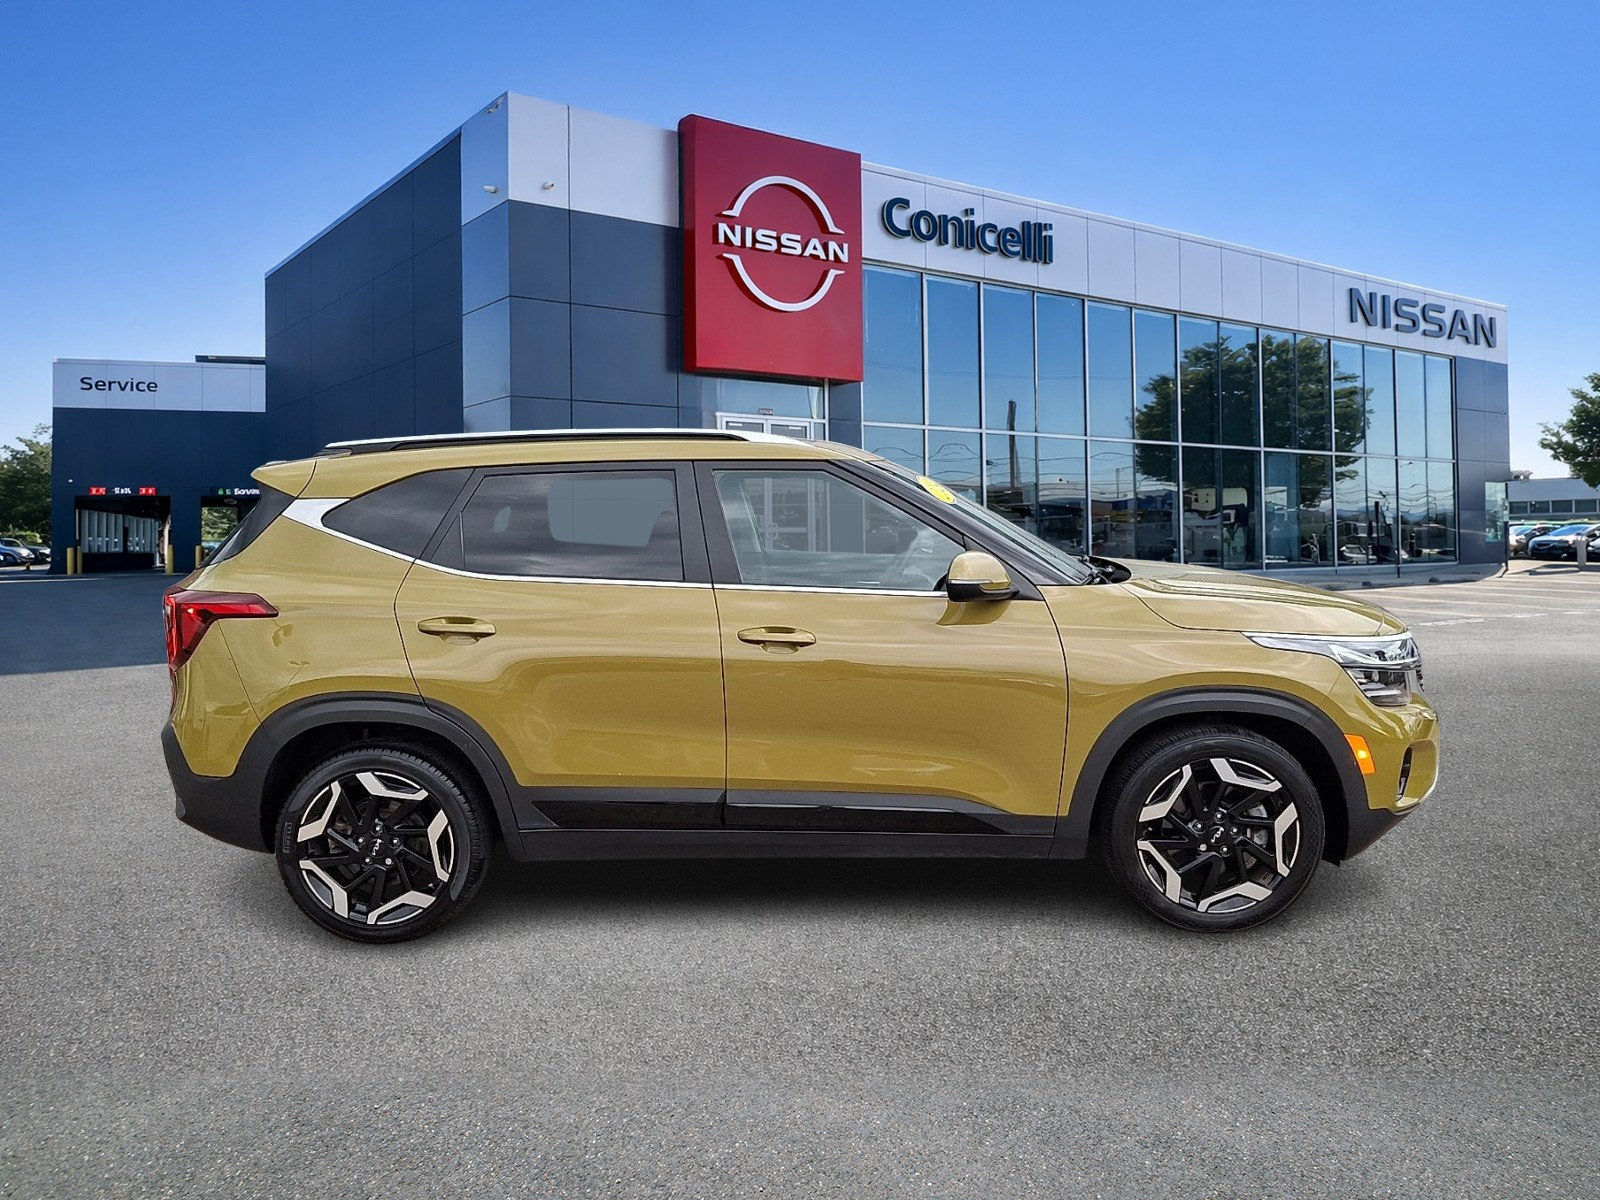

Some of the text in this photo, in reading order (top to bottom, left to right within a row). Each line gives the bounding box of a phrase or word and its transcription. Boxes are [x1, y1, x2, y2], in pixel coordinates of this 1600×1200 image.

[716, 222, 849, 264] NISSAN
[881, 197, 1053, 264] Conicelli
[1348, 287, 1497, 348] NISSAN
[80, 376, 158, 392] Service
